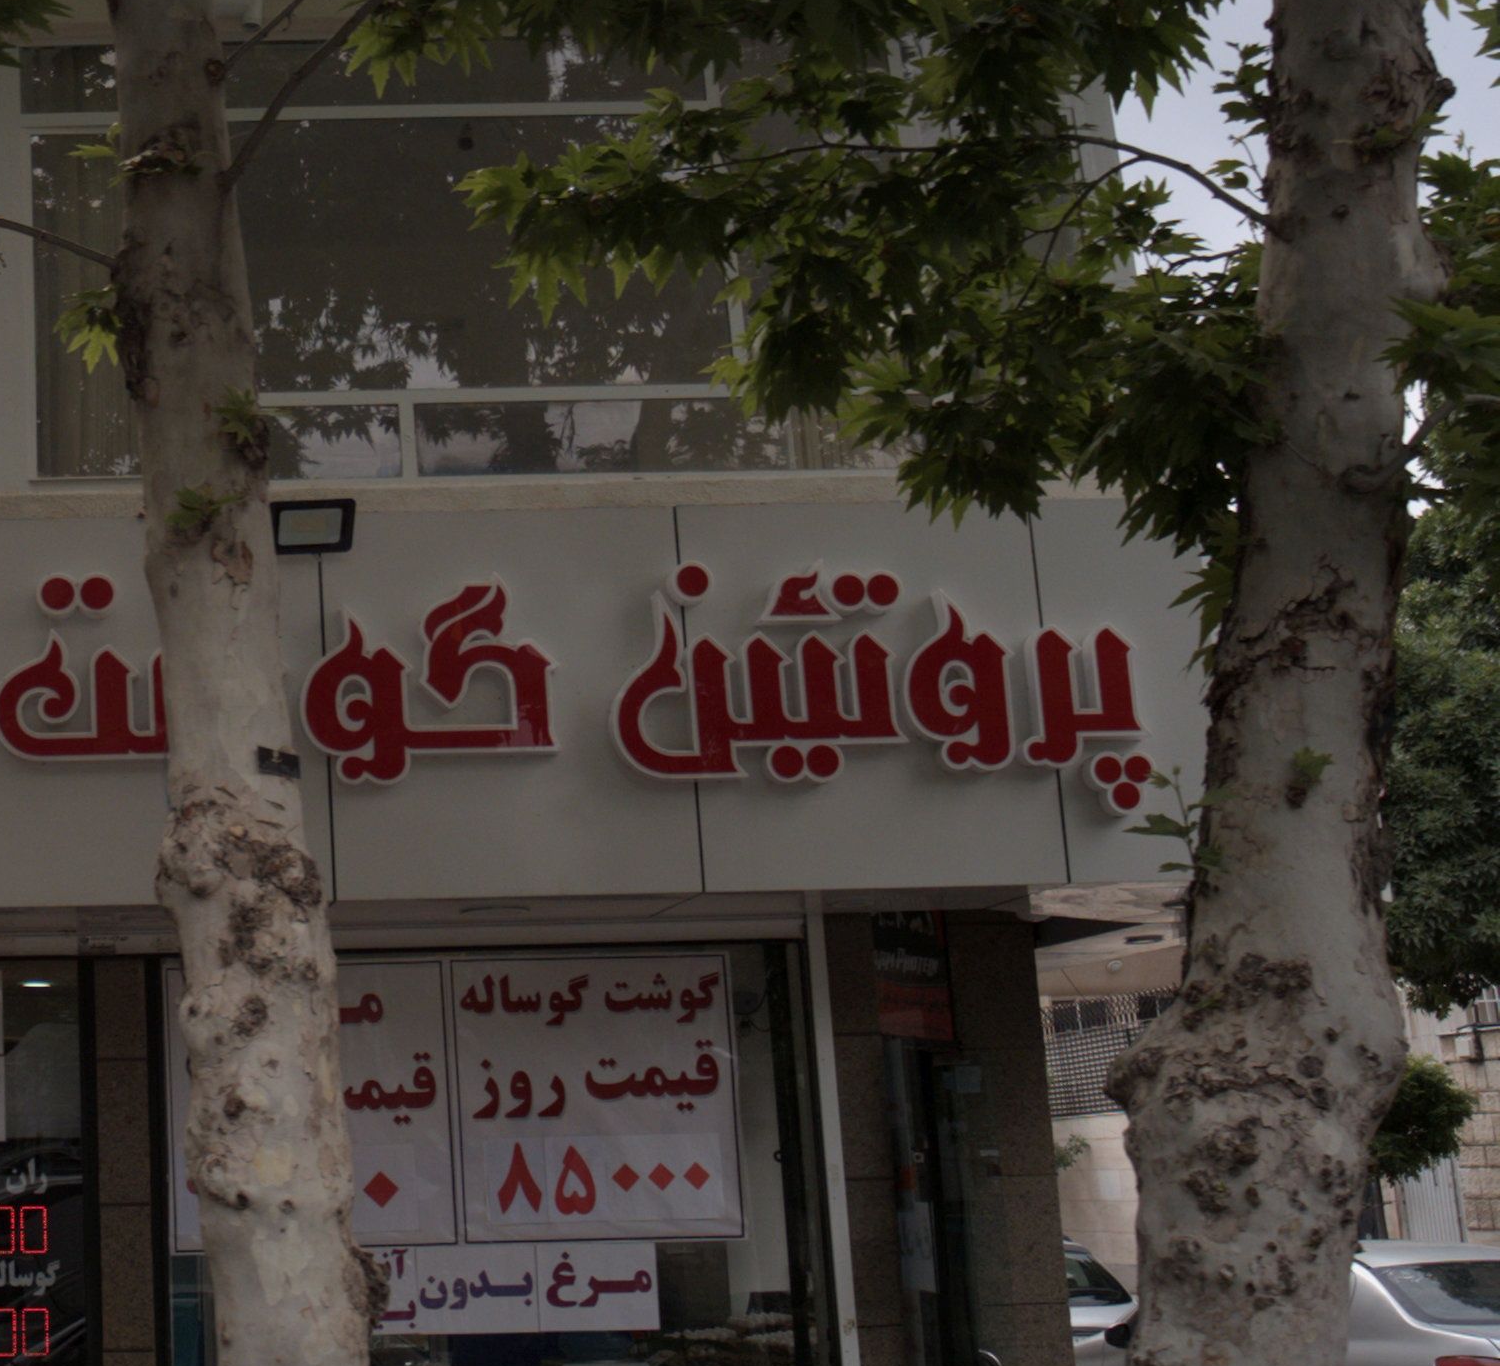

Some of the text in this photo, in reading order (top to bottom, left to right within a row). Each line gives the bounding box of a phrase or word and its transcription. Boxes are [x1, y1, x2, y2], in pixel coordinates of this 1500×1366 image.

[613, 562, 1152, 815] پروتئین
[460, 972, 720, 1026] گوشت گوساله
[343, 1051, 437, 1124] قیم
[473, 1038, 720, 1119] قیمت روز
[496, 1142, 710, 1215] ۸۵۰۰۰
[419, 1251, 653, 1311] مرغ بدون
